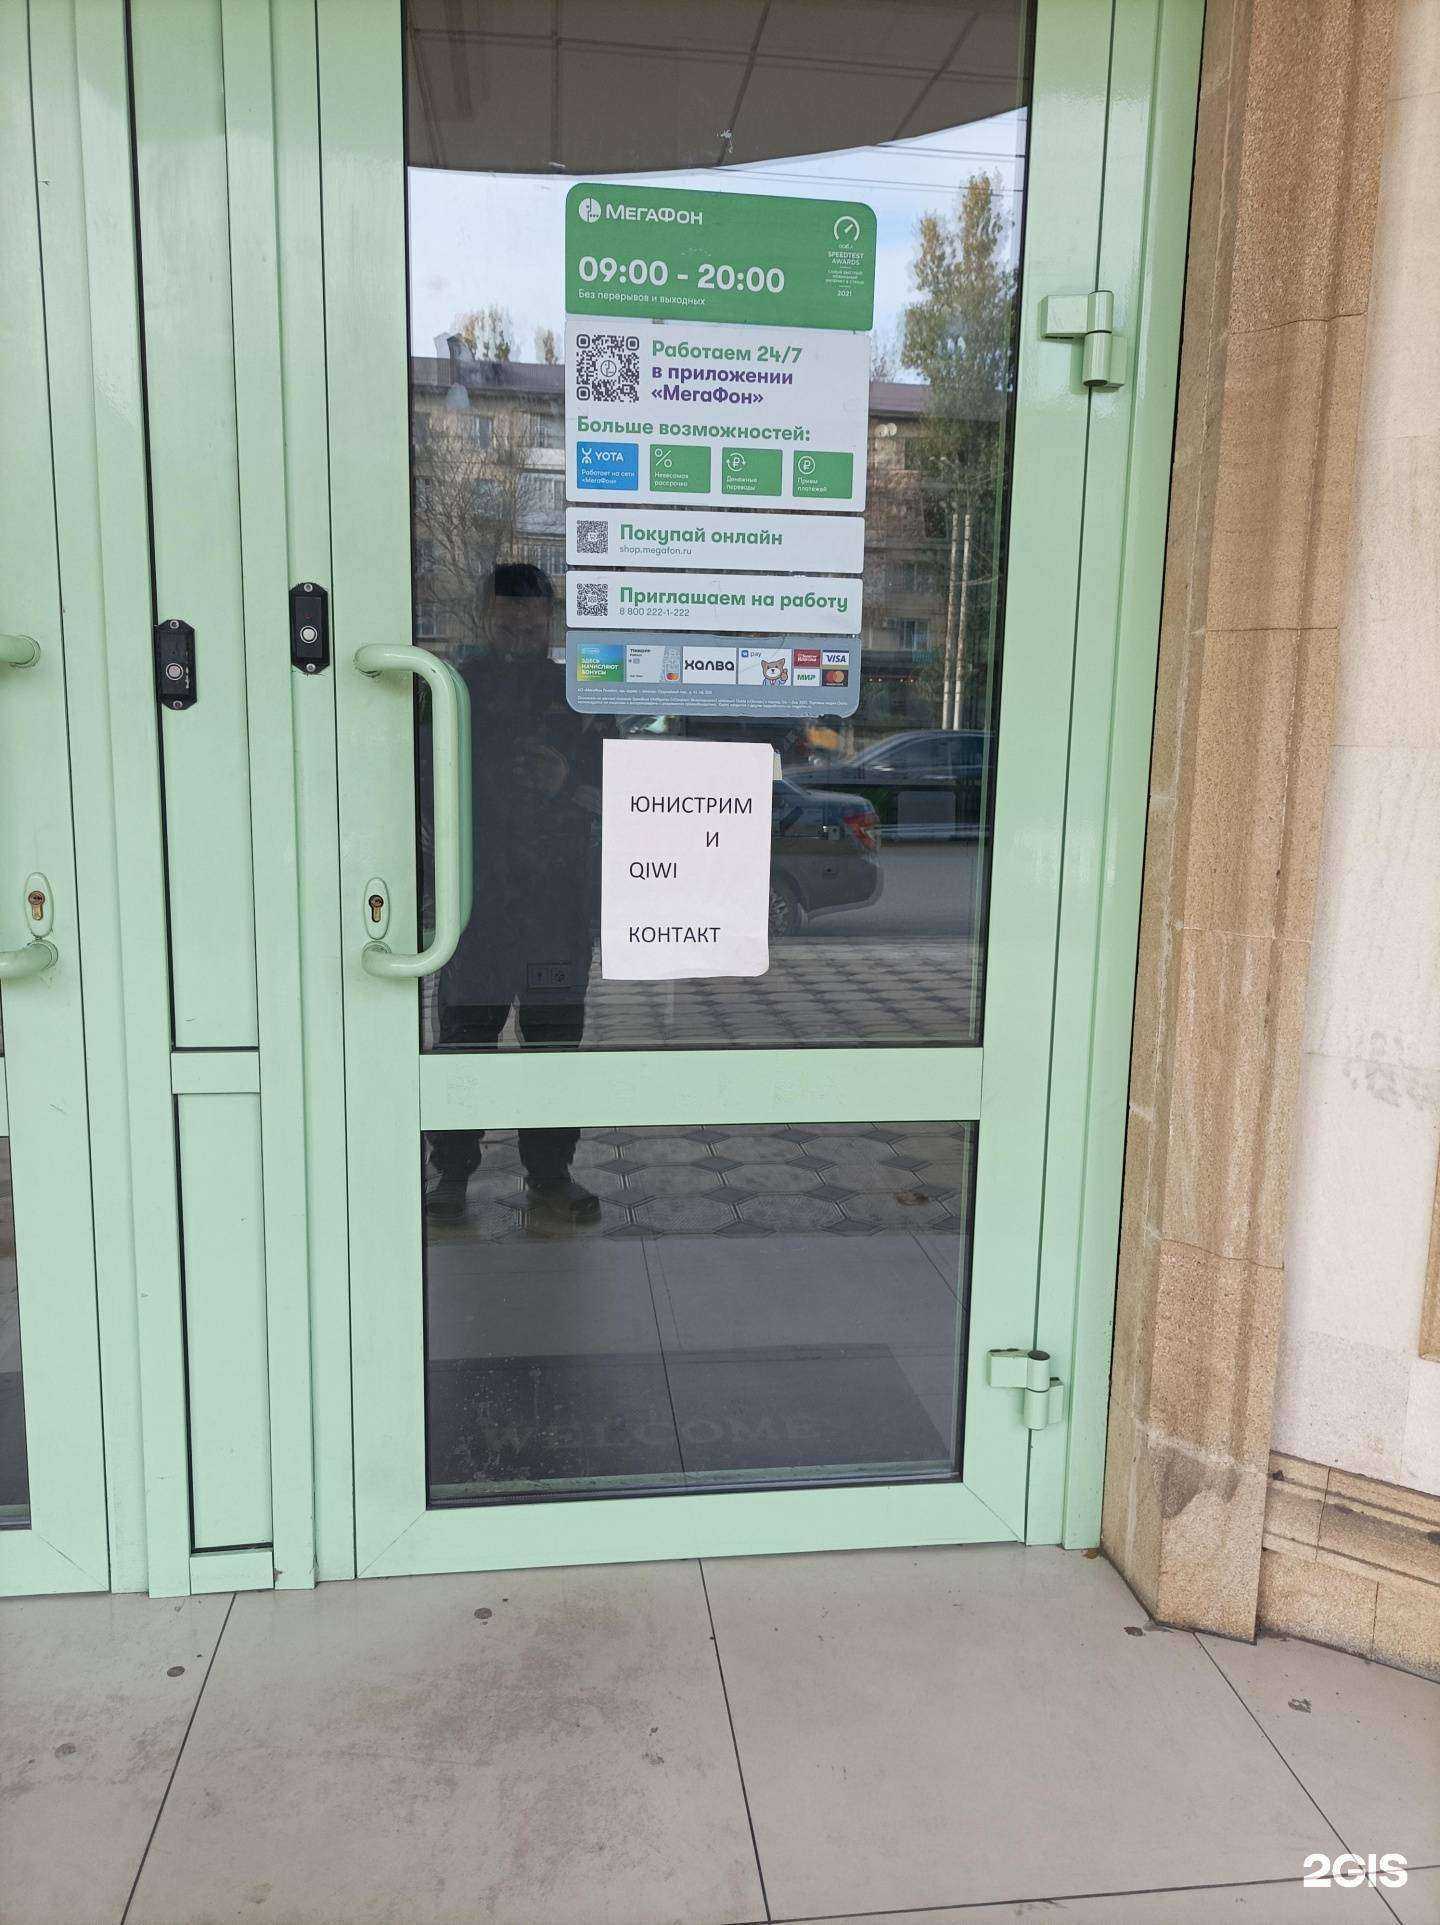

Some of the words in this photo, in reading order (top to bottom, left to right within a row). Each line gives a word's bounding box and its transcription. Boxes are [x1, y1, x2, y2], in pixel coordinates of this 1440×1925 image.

[832, 258, 860, 266] AWARDS
[578, 255, 669, 286] 09:00
[697, 263, 785, 293] 20:00
[578, 288, 595, 299] Без
[597, 291, 649, 303] перерывов
[651, 294, 658, 302] и
[659, 294, 705, 305] выходных
[652, 340, 751, 361] Работаем
[756, 345, 802, 364] 24/7
[652, 366, 662, 379] в
[668, 367, 793, 385] приложении
[651, 384, 763, 405] «МегаФон»
[577, 416, 653, 434] Больше
[659, 420, 811, 441] возможностей:
[595, 451, 624, 462] YOTA
[582, 468, 610, 477] Работает
[619, 523, 706, 546] Покупай
[711, 528, 783, 546] онлайн
[619, 545, 692, 556] shop.megafon.ru
[619, 586, 747, 607] Приглашаем
[751, 593, 775, 607] на
[780, 590, 849, 613] работу
[619, 608, 626, 616] 8
[627, 608, 645, 616] 800
[646, 608, 690, 617] 222-1-222
[826, 654, 847, 663] VISA
[630, 795, 752, 814] ЮНИСТРИМ
[706, 831, 719, 847] И
[629, 861, 678, 880] QIWI
[629, 926, 721, 943] КОНТАКТ
